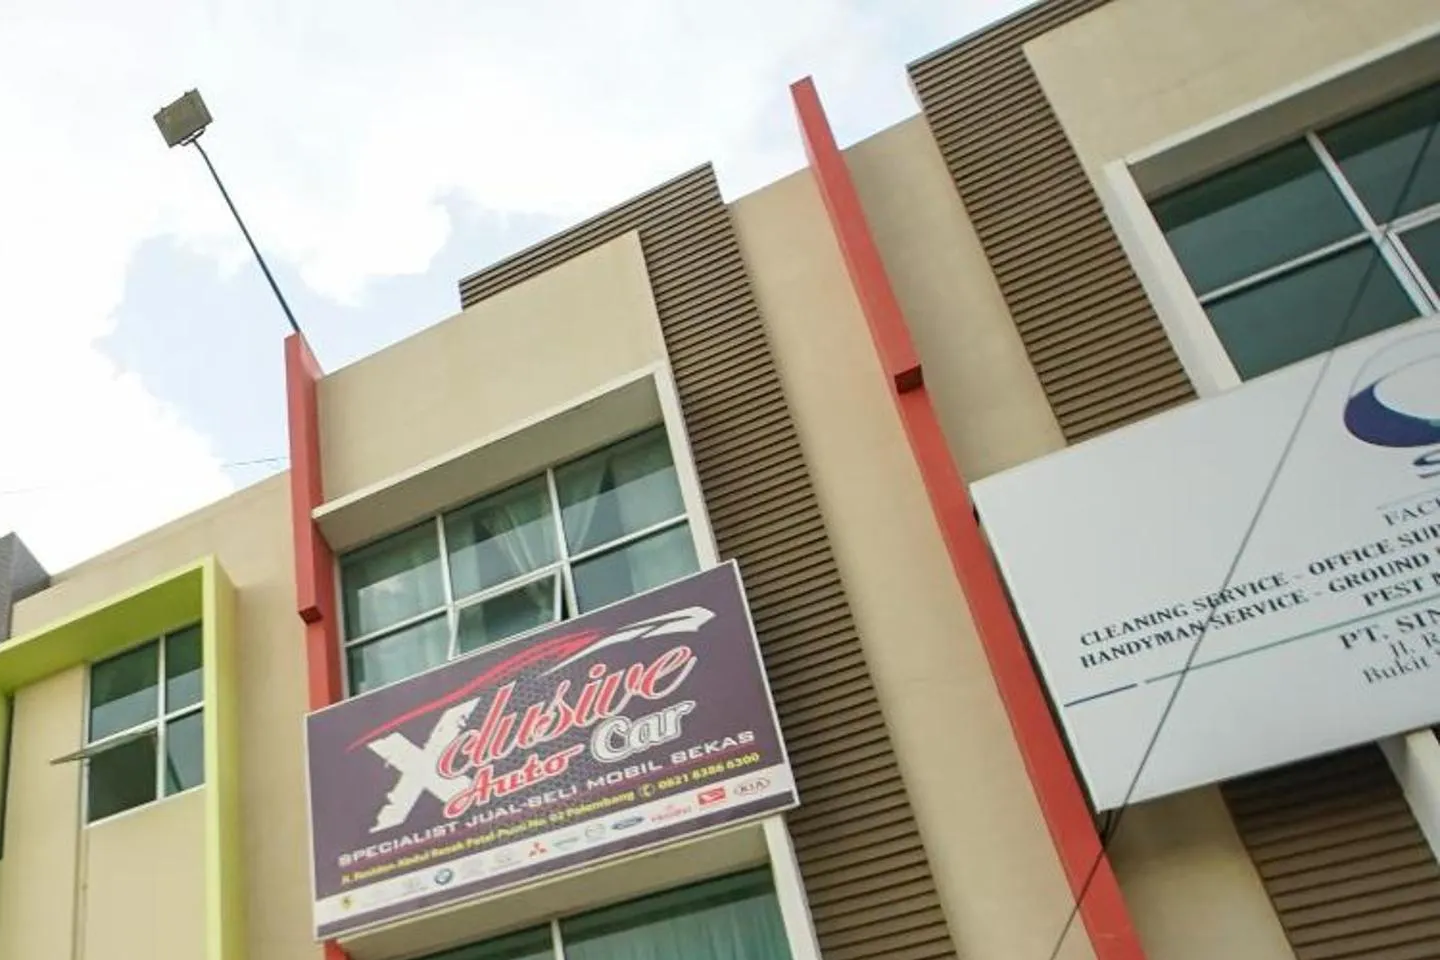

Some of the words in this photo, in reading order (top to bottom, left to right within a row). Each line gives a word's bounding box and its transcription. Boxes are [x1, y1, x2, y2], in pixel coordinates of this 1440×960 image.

[1080, 603, 1189, 646] CLEANING
[1192, 572, 1289, 612] SERVICE
[1309, 539, 1394, 576] OFFICE
[1080, 619, 1205, 669] HANDYMAN
[1210, 589, 1309, 630] SERVICE
[1328, 552, 1430, 593] GROUND
[1338, 624, 1389, 649] PT.
[1363, 577, 1424, 607] PEST
[1363, 656, 1430, 684] Bukit
[338, 821, 460, 868] SPECIALIST
[464, 785, 577, 828] JUAL-BELI
[587, 760, 663, 791] MOBIL
[670, 731, 756, 765] BEKAS
[444, 743, 586, 819] Auto
[590, 700, 696, 763] Car
